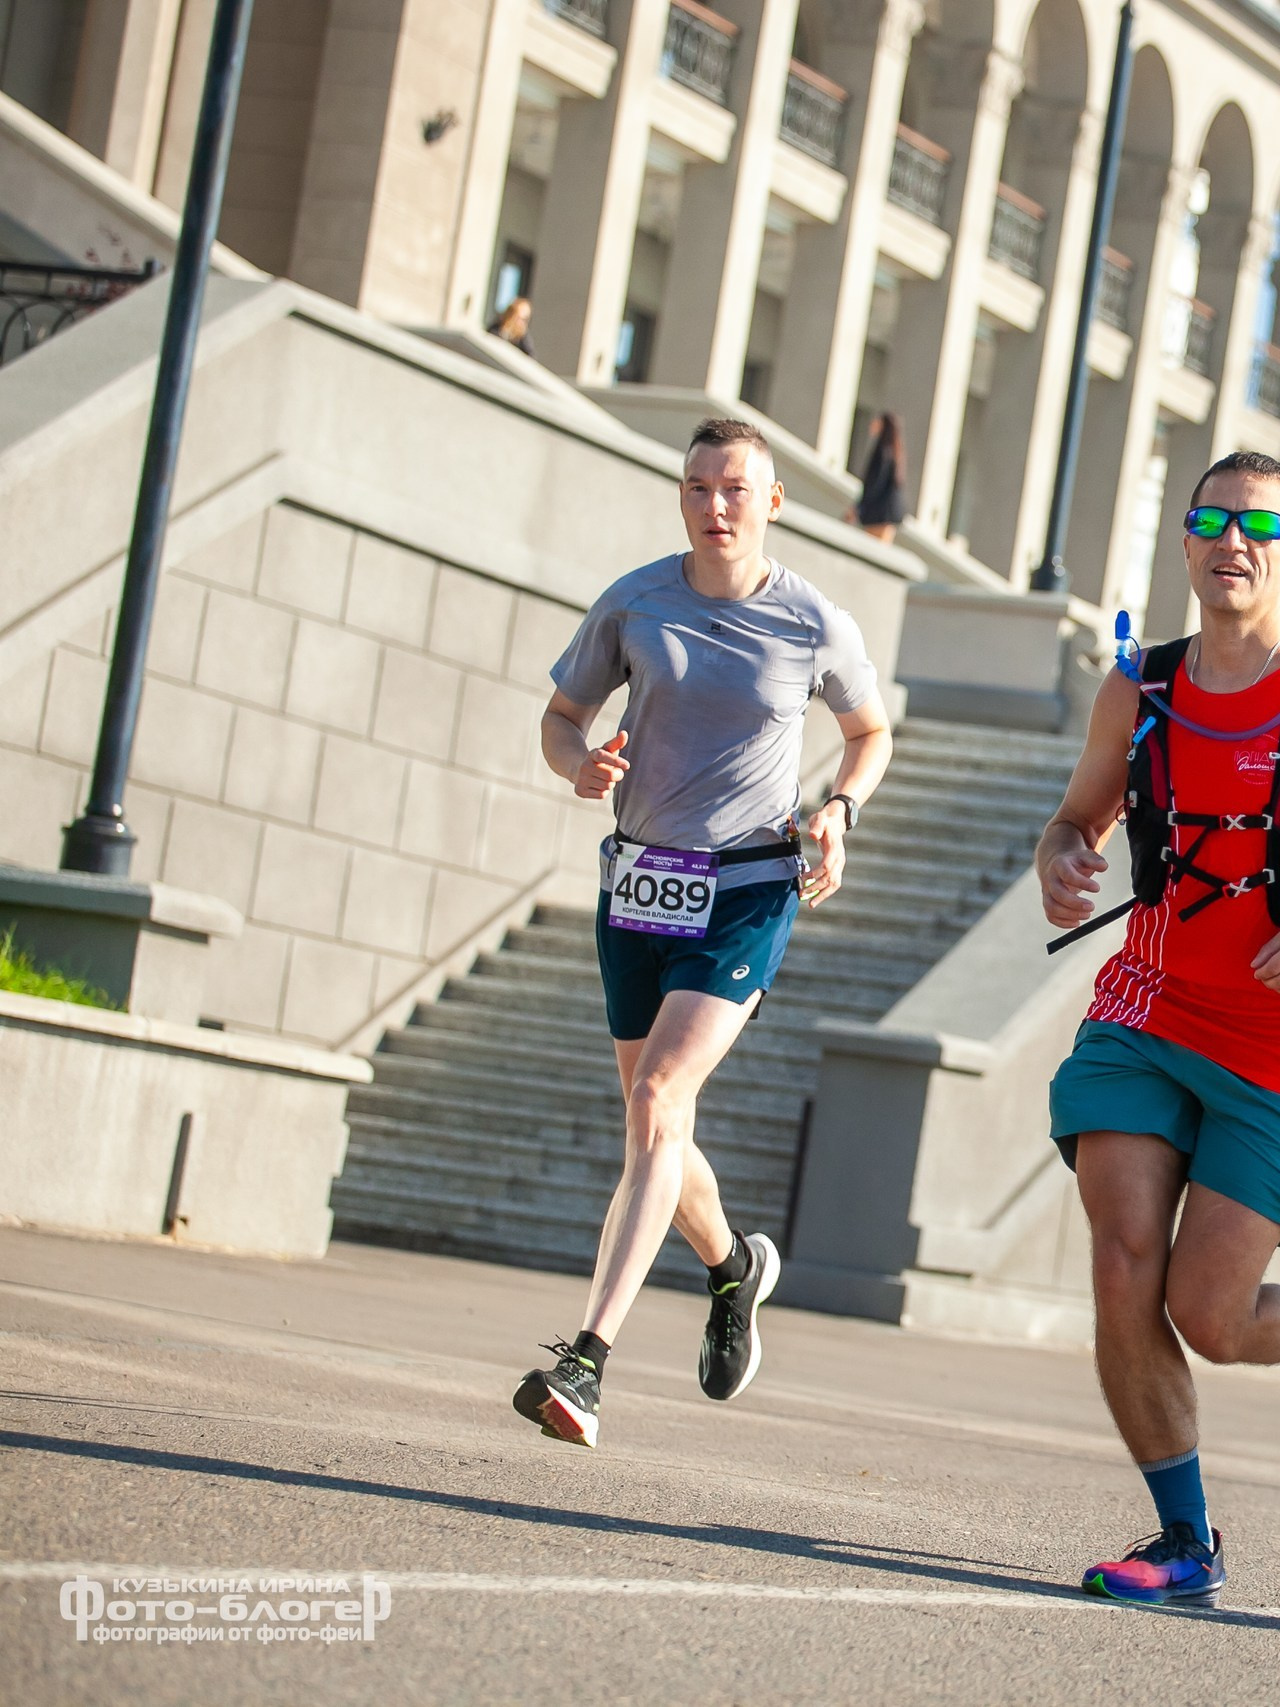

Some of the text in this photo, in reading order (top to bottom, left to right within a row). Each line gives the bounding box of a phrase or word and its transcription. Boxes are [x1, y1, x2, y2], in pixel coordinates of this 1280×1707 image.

[643, 854, 684, 864] КРАСНОЯРСКИЕ
[614, 872, 711, 914] 4089
[622, 907, 694, 922] КОРТЕЛЕВ ВЛАДИСЛАВ
